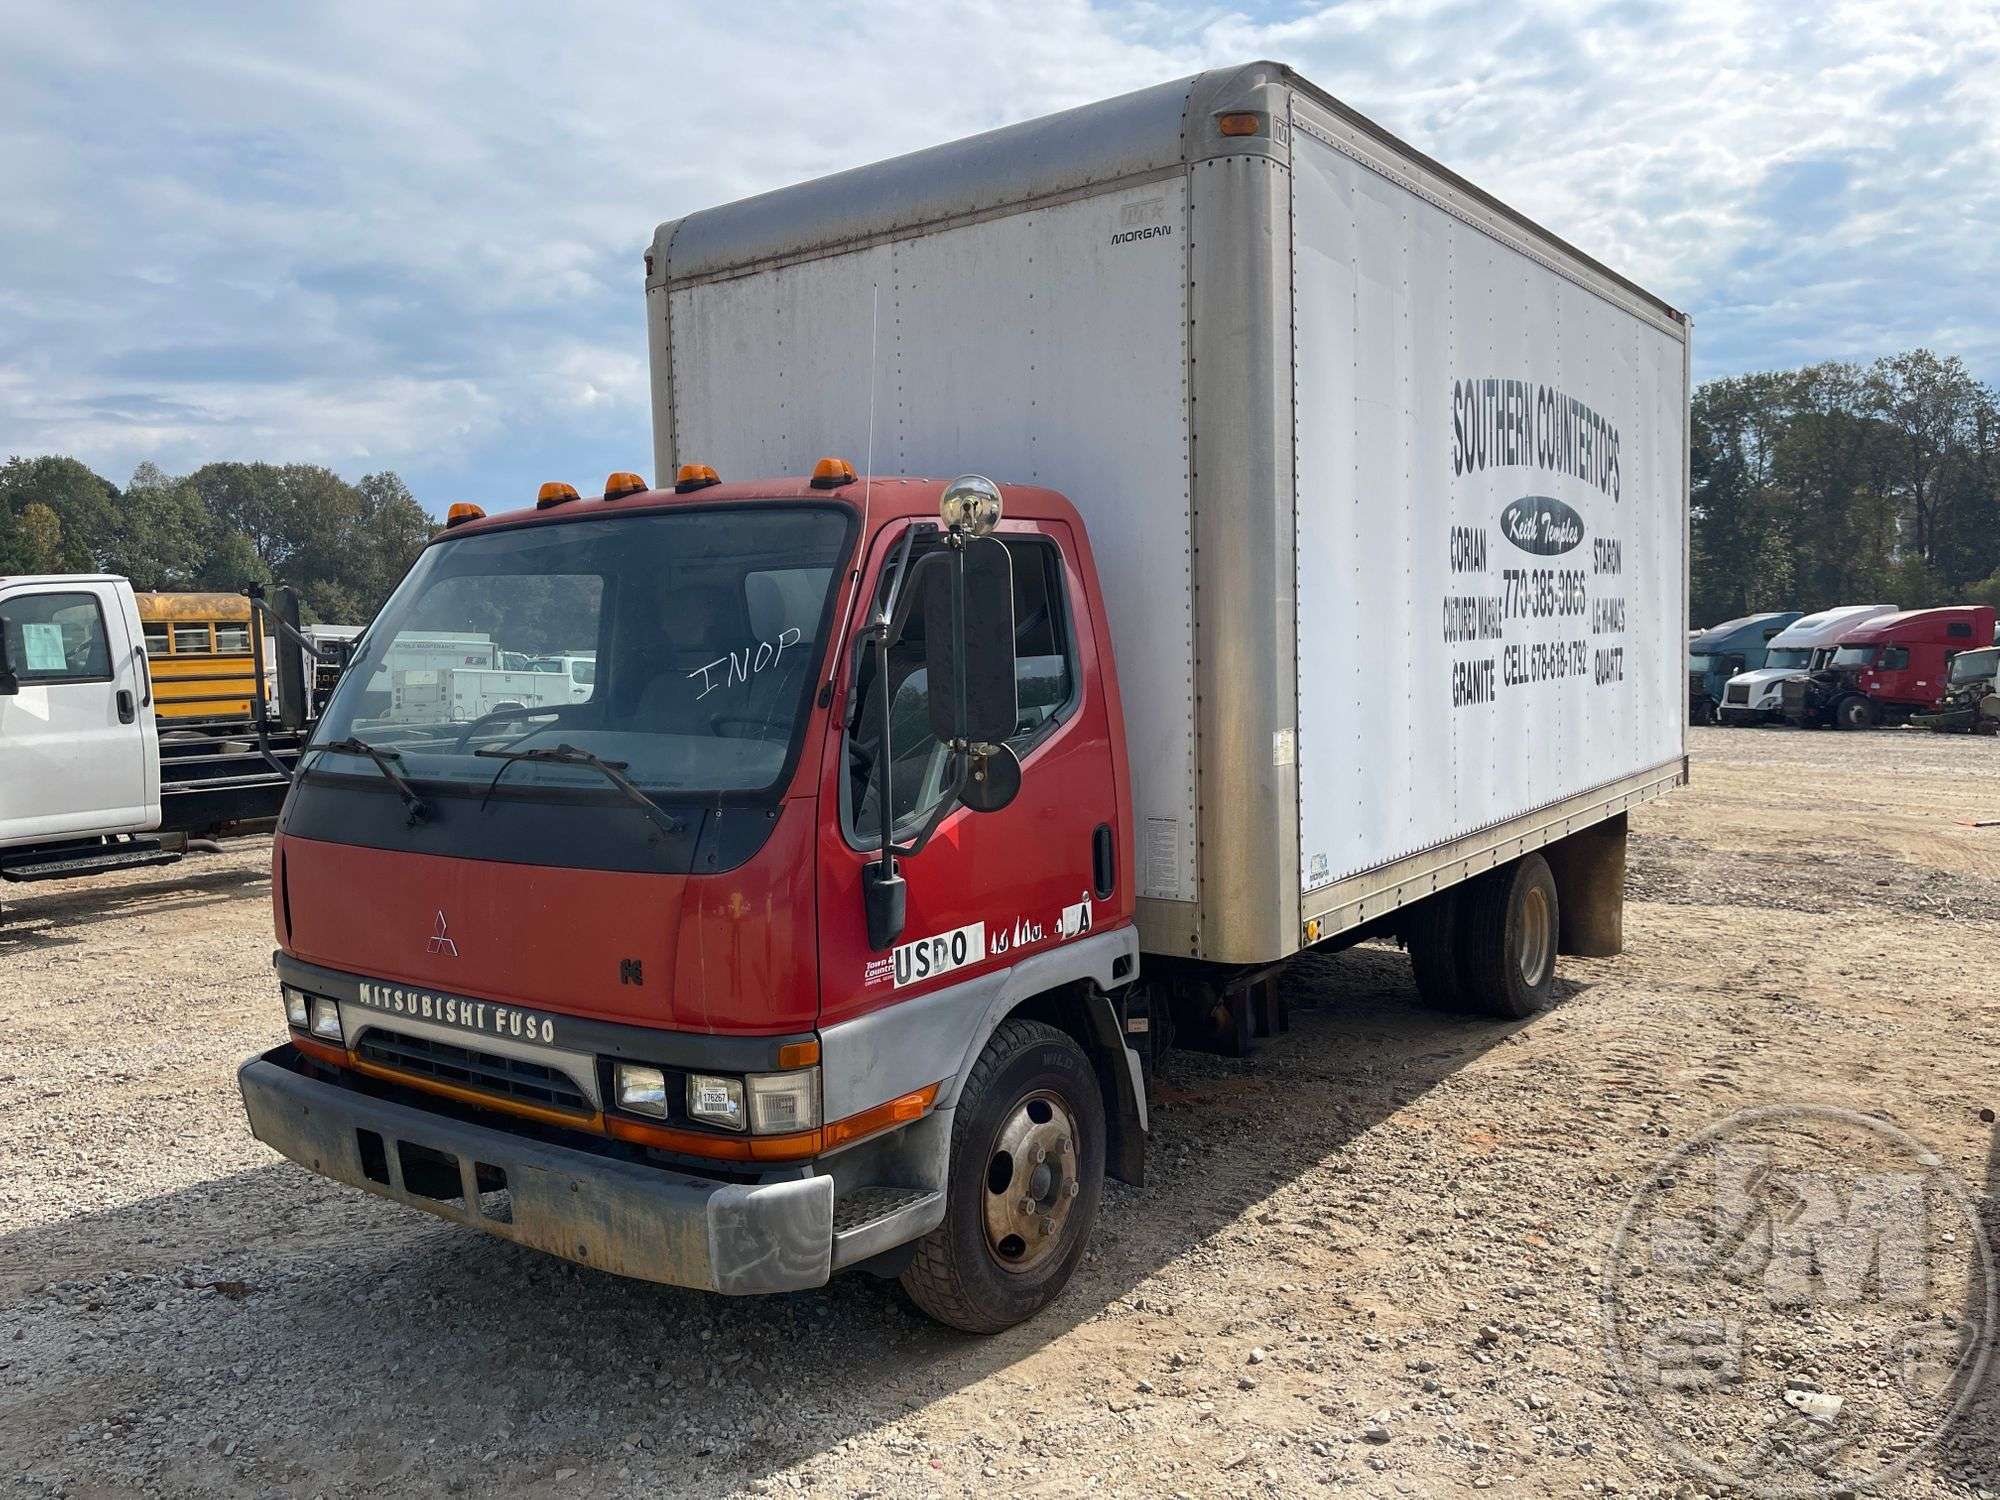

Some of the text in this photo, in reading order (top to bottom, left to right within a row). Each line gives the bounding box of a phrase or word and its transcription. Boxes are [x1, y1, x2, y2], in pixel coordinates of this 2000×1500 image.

[1111, 225, 1172, 246] MORGAN
[1454, 378, 1621, 504] SOUTHERN COUNTERTOPS
[1451, 525, 1487, 574] CORIAN
[686, 627, 801, 701] INOP
[1452, 659, 1496, 708] GRANITE
[1503, 644, 1529, 687] CELL
[359, 982, 555, 1043] MITSUBISHI FUSO
